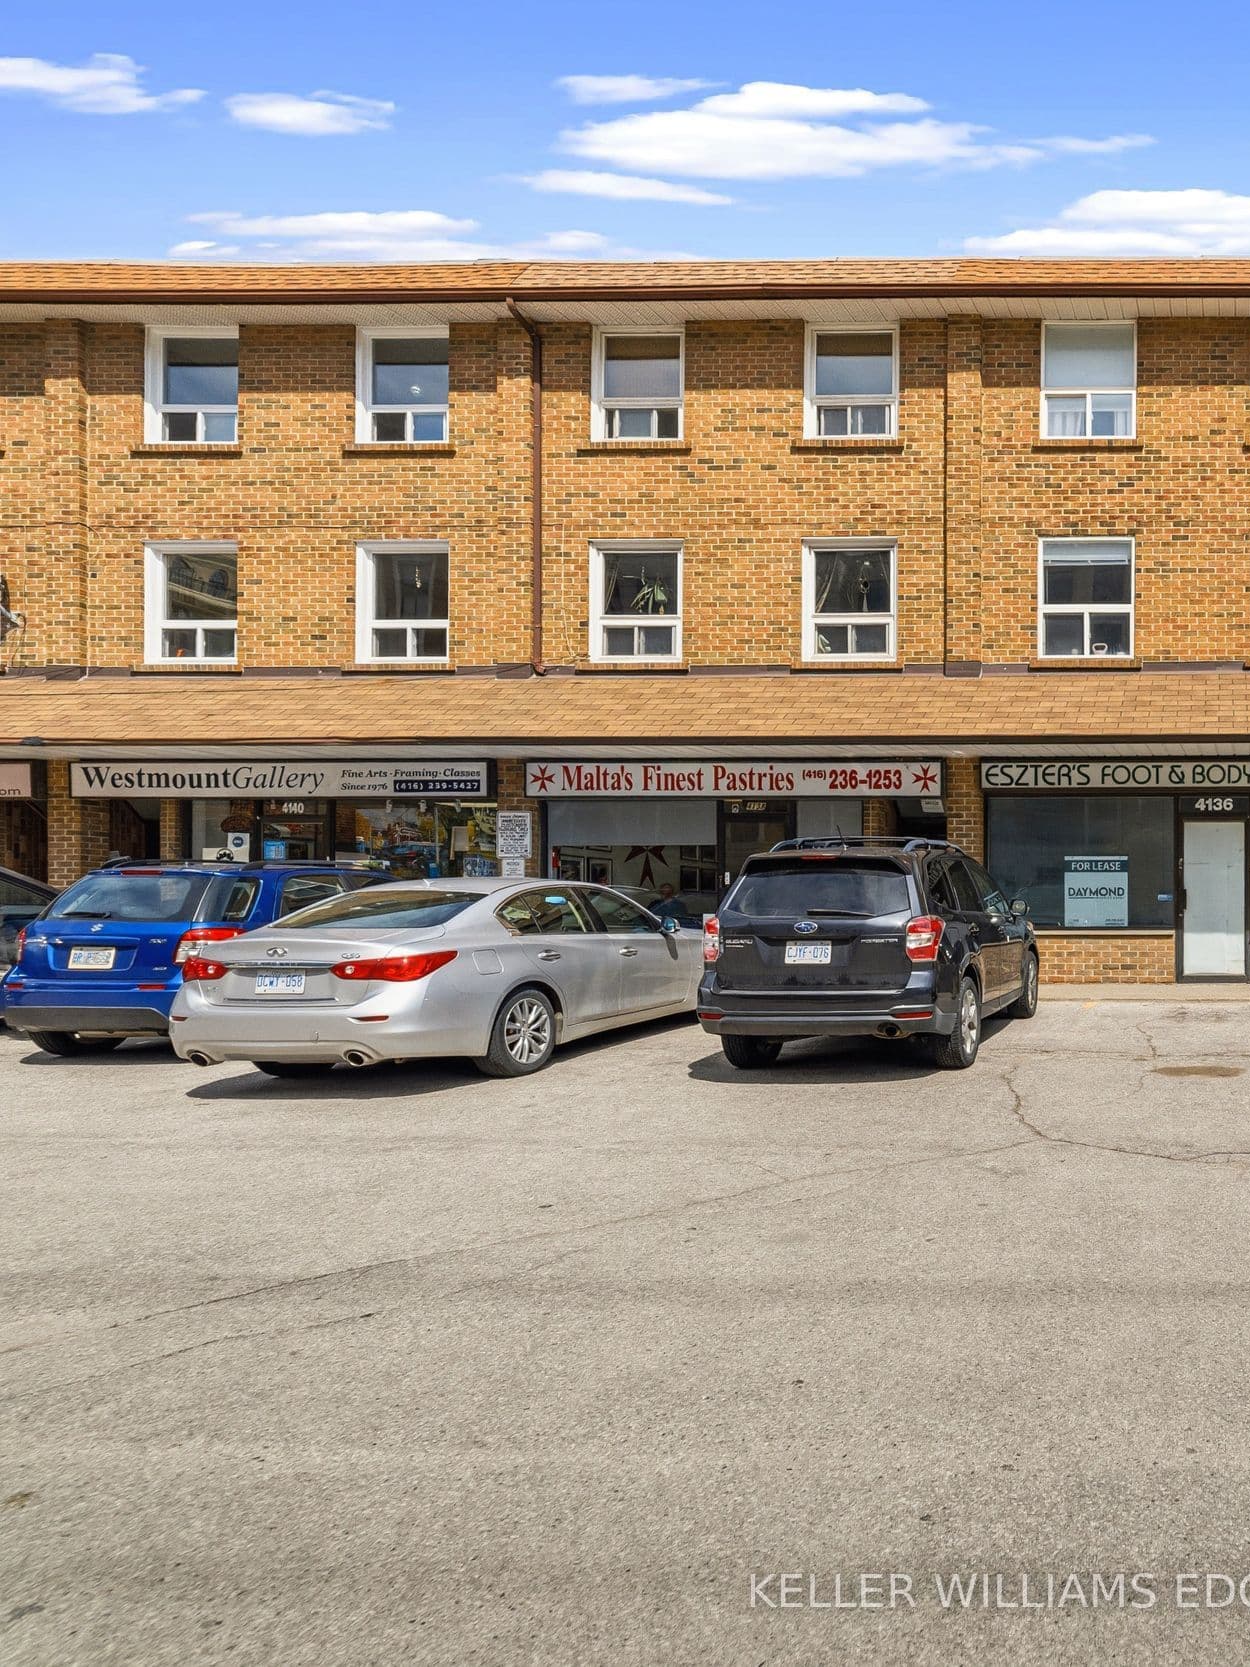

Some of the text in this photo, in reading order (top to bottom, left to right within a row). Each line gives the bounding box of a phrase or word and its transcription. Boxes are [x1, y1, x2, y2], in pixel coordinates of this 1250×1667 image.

[341, 769, 364, 778] Fine
[366, 769, 388, 778] Arts
[443, 768, 481, 777] Classes
[561, 764, 903, 792] Malta's Finest Pastries (416) 236-1253
[985, 764, 1091, 786] ESZTER'S
[1101, 764, 1163, 785] FOOT
[1168, 765, 1186, 784] &
[395, 782, 424, 790] (416)
[282, 803, 304, 814] 4140
[1195, 798, 1233, 811] 4136
[1072, 861, 1121, 871] FOR LEASE
[1068, 887, 1125, 897] DAYMOND
